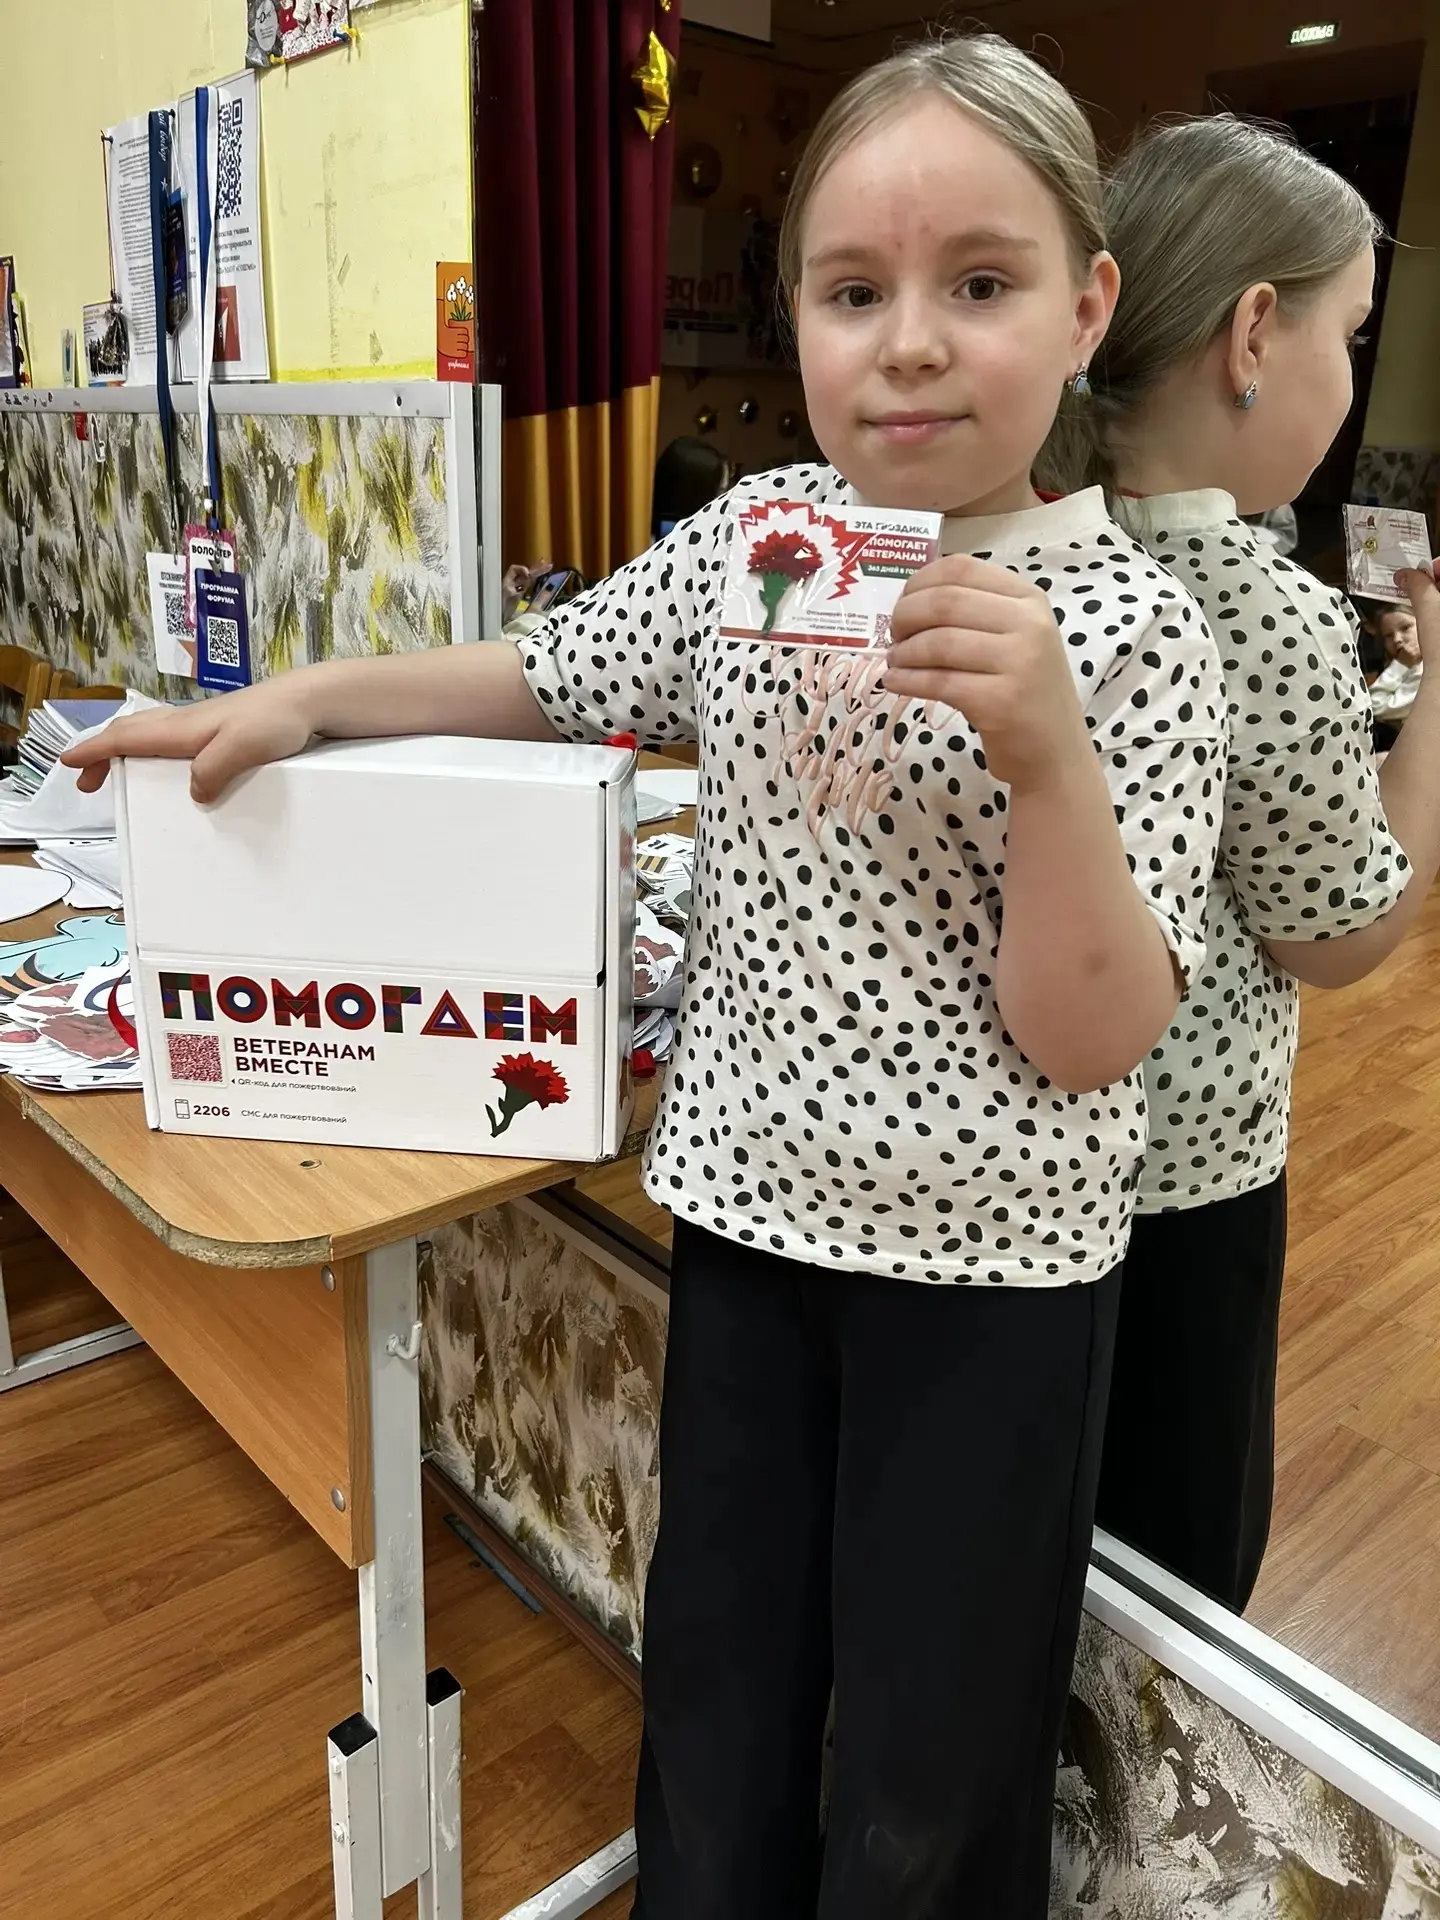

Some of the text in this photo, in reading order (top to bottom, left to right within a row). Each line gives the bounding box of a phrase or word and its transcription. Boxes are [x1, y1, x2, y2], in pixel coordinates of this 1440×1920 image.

[854, 521, 873, 530] ЭТА
[869, 537, 928, 551] ПОМОГАЕТ
[192, 545, 232, 559] ВОЛОТЕР
[861, 549, 927, 562] ВЕТЕРАНАМ
[200, 582, 239, 595] ПРОГРАММА
[206, 594, 235, 605] ФОРУМА
[158, 971, 578, 1046] ПОМОГАЕМ
[233, 1037, 375, 1061] ВЕТЕРАНАМ
[236, 1056, 329, 1077] ВМЕСТЕ
[238, 1078, 357, 1093] QR-код для пожертвований
[193, 1105, 348, 1124] 2206 СМС для пожертвований
